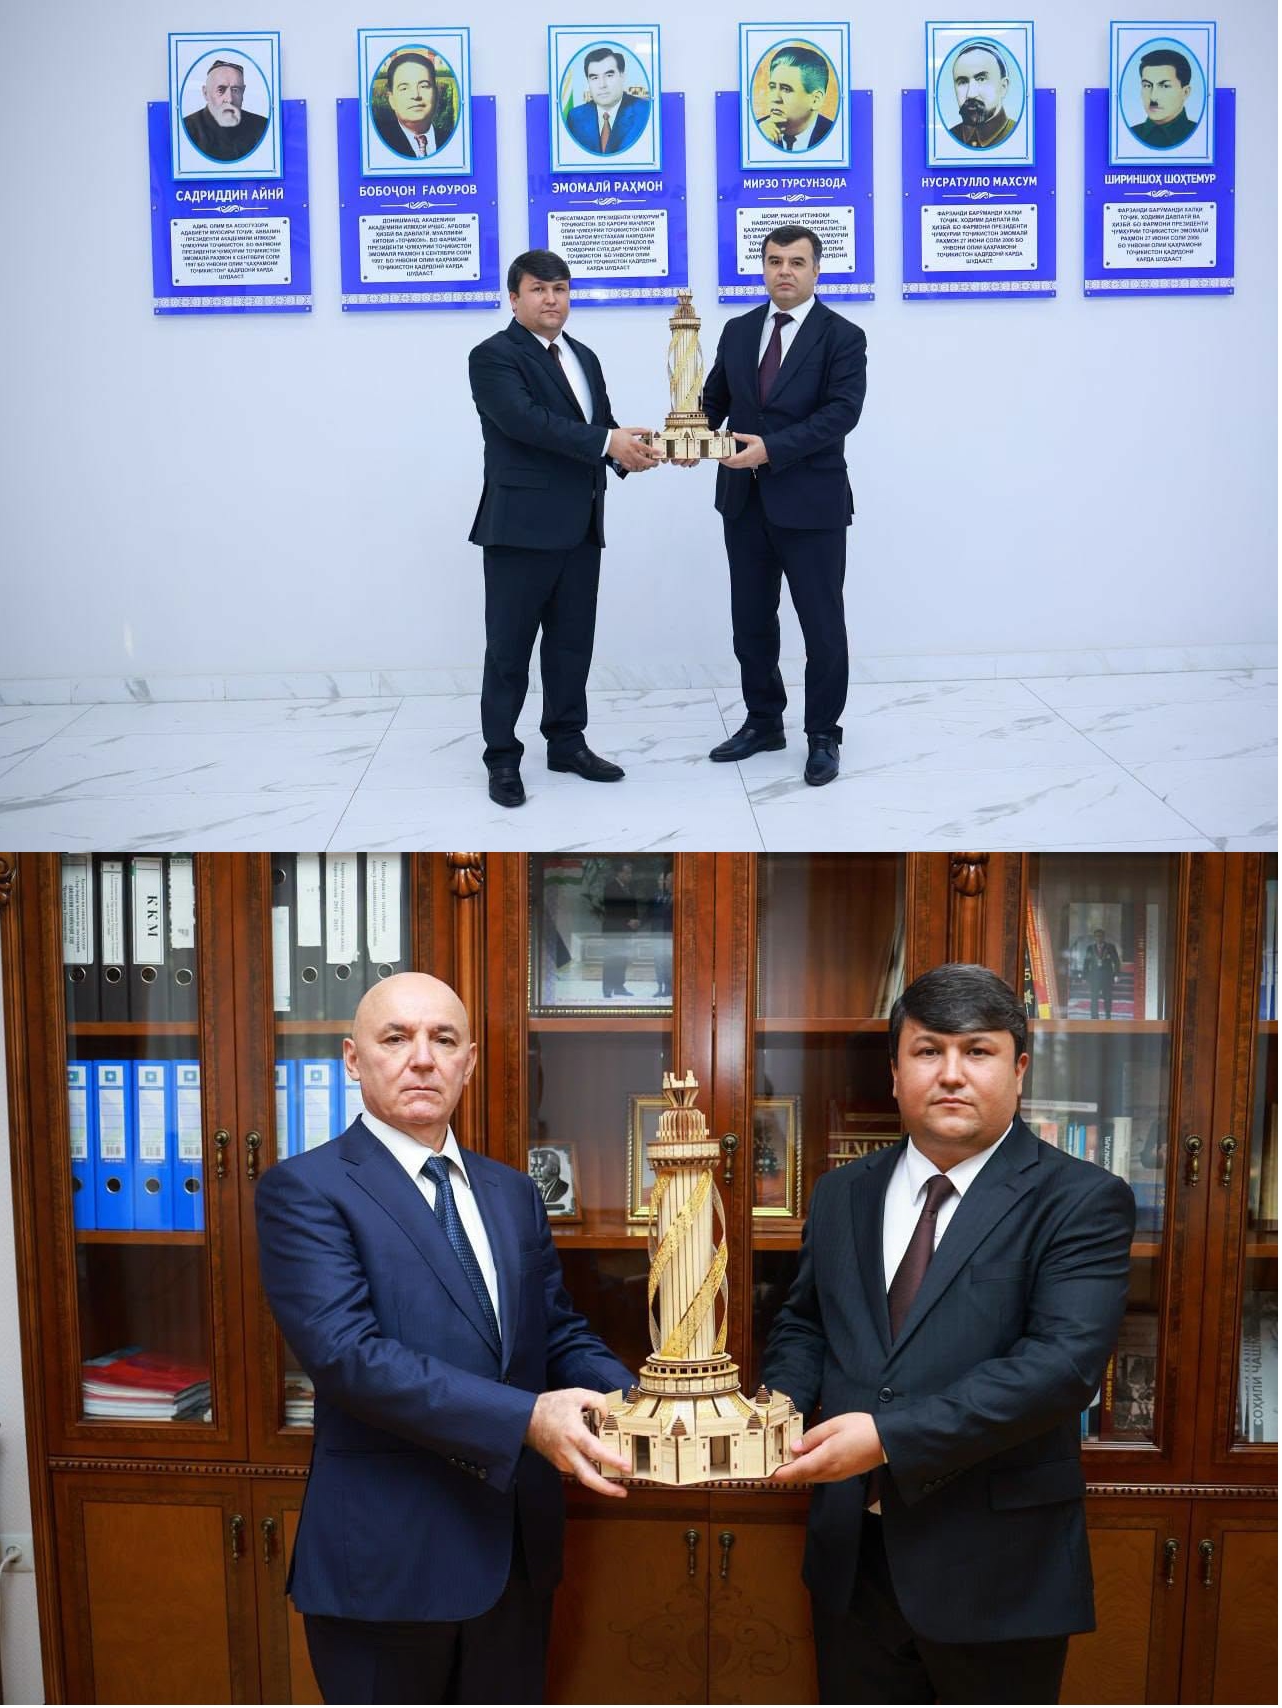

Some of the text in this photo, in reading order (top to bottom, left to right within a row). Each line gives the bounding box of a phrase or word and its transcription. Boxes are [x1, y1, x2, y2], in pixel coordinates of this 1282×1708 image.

[744, 178, 846, 188] МИРЗО ТУРСУНЗОДА
[922, 177, 1037, 187] НУСРАТУЛЛО МАХСУМ
[1105, 174, 1215, 185] ШИРИНШОҲ ШОҲТЕМУР
[360, 185, 477, 197] БОБОҶОН ҒАФУРОВ
[552, 181, 662, 193] ЭМОМАЛӢ РАҲМОН
[176, 187, 283, 202] САДРИДДИН АЙНӢ
